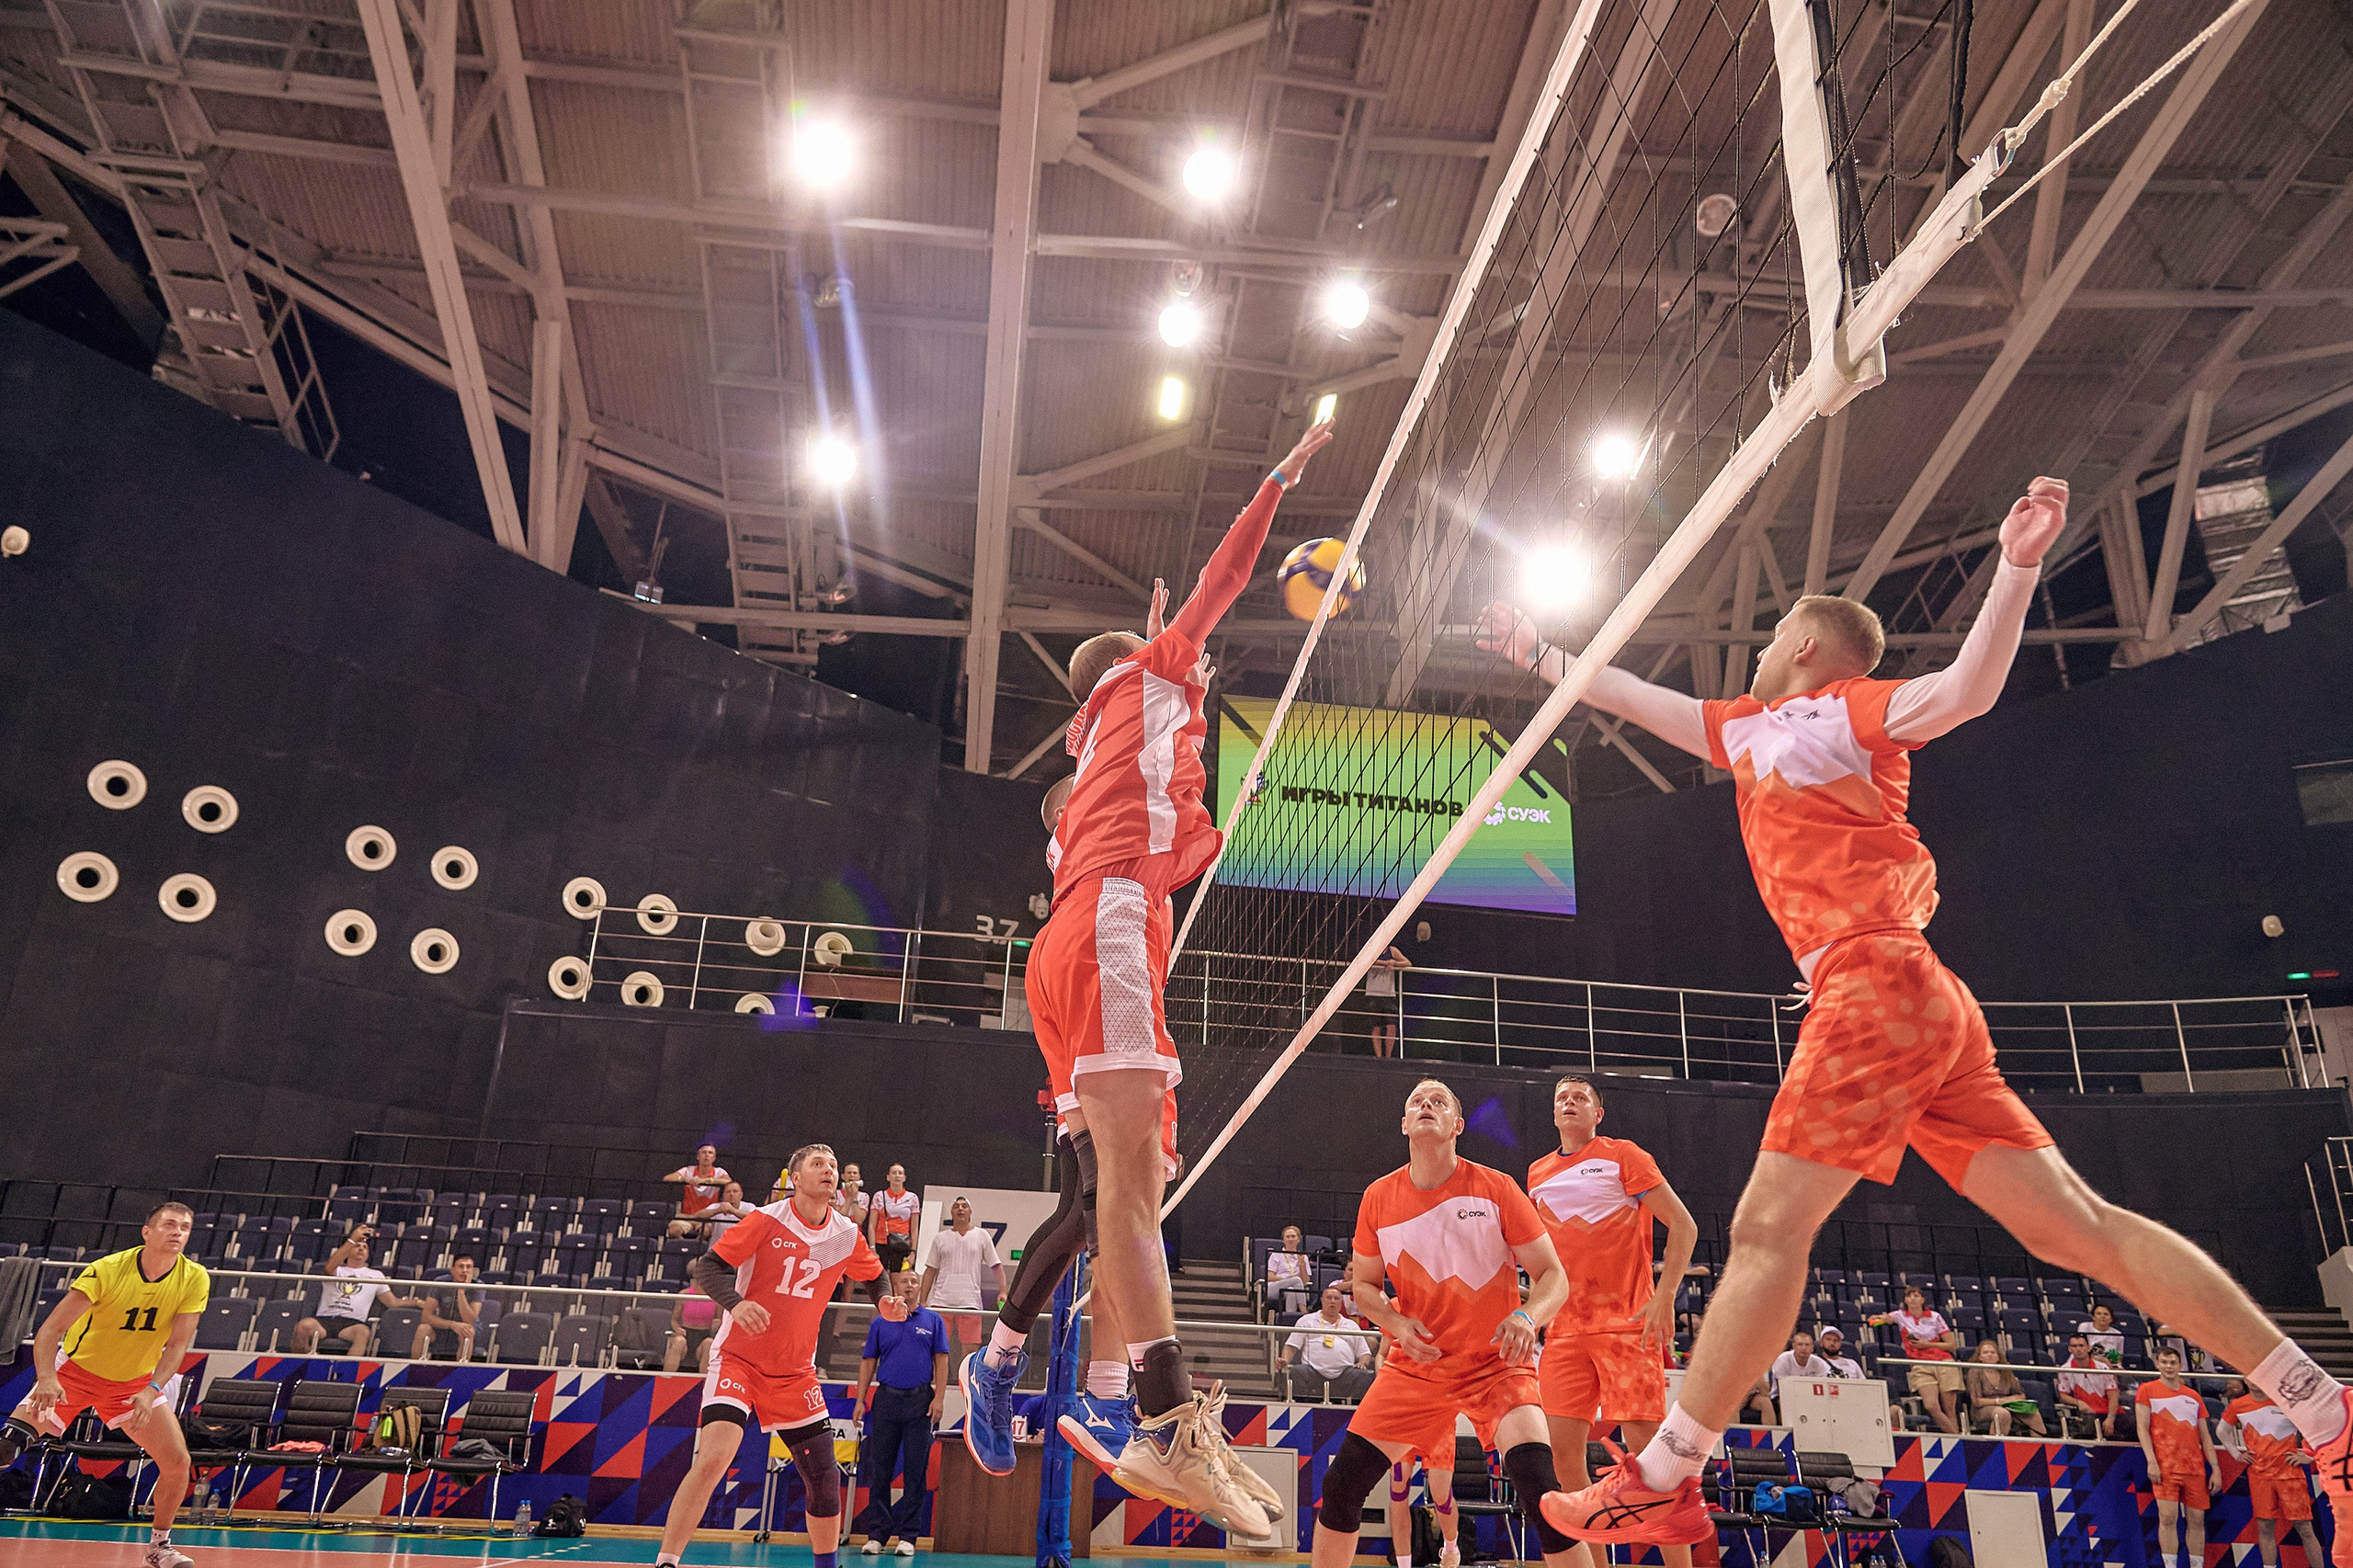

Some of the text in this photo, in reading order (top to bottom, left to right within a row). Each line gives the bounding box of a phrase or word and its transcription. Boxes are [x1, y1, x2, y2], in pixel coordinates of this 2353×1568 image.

[1281, 785, 1464, 816] ИГРЫ ТИТАНОВ
[1507, 806, 1552, 824] СУЭК
[775, 1256, 822, 1299] 12
[119, 1307, 158, 1331] 11
[803, 1385, 825, 1411] 12
[1012, 1420, 1025, 1435] 17
